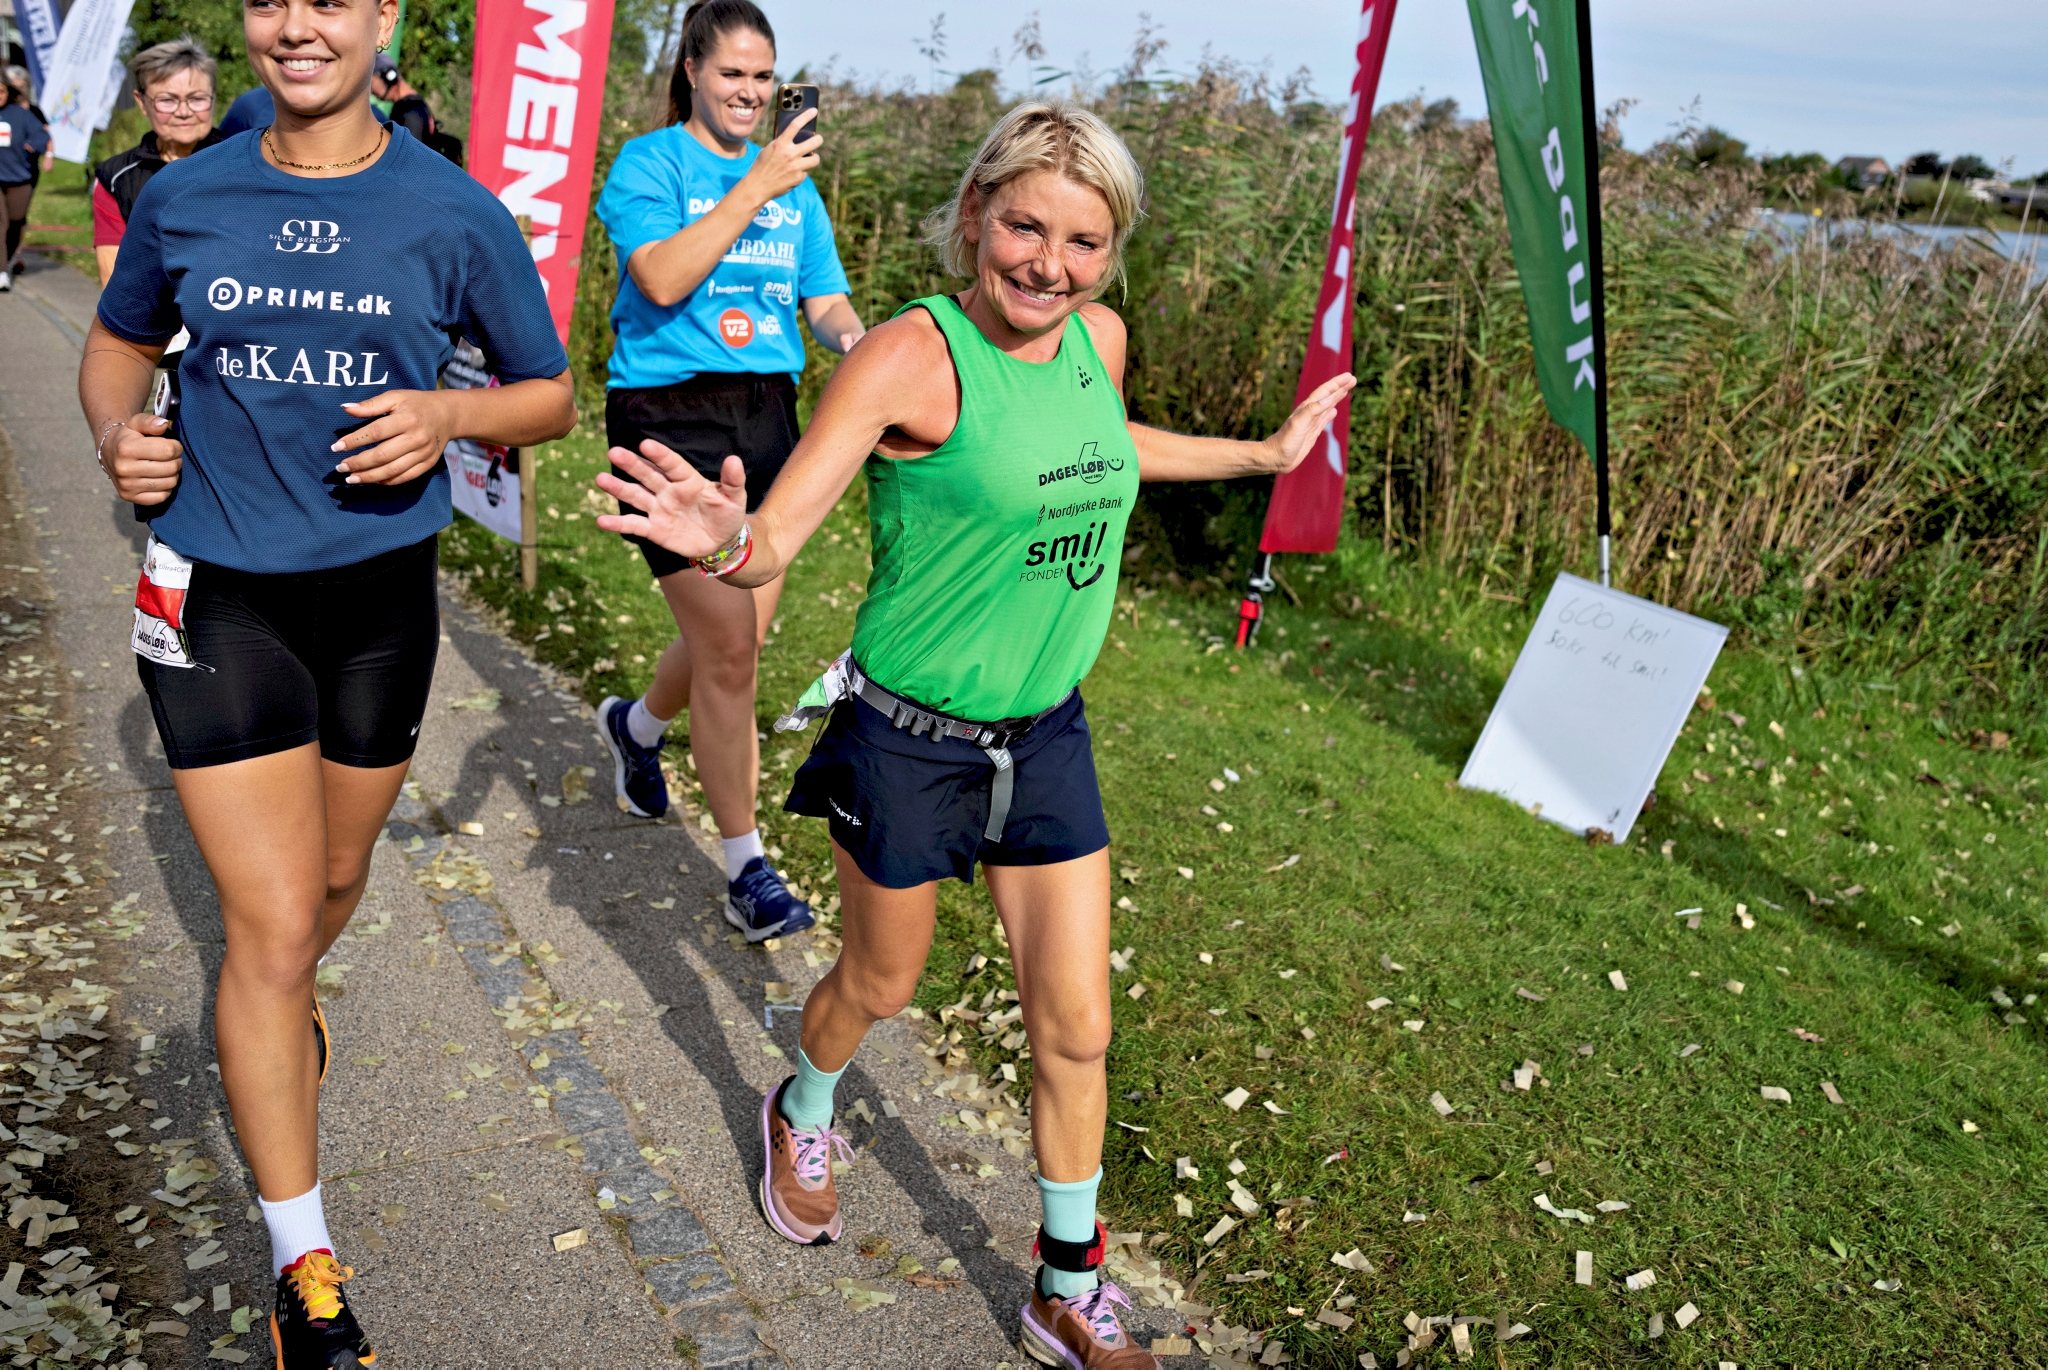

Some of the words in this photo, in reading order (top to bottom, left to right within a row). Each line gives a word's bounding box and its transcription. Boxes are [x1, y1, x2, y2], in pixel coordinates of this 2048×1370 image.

[269, 234, 294, 242] SILLE
[297, 236, 351, 244] BERGSMAN
[247, 286, 391, 315] PRIME.dk
[1038, 464, 1079, 487] DAGES
[1081, 460, 1105, 475] LØB
[1048, 500, 1097, 520] Nordjyske
[1099, 496, 1124, 510] Bank
[1558, 596, 1615, 631] 600
[152, 637, 166, 650] LØB
